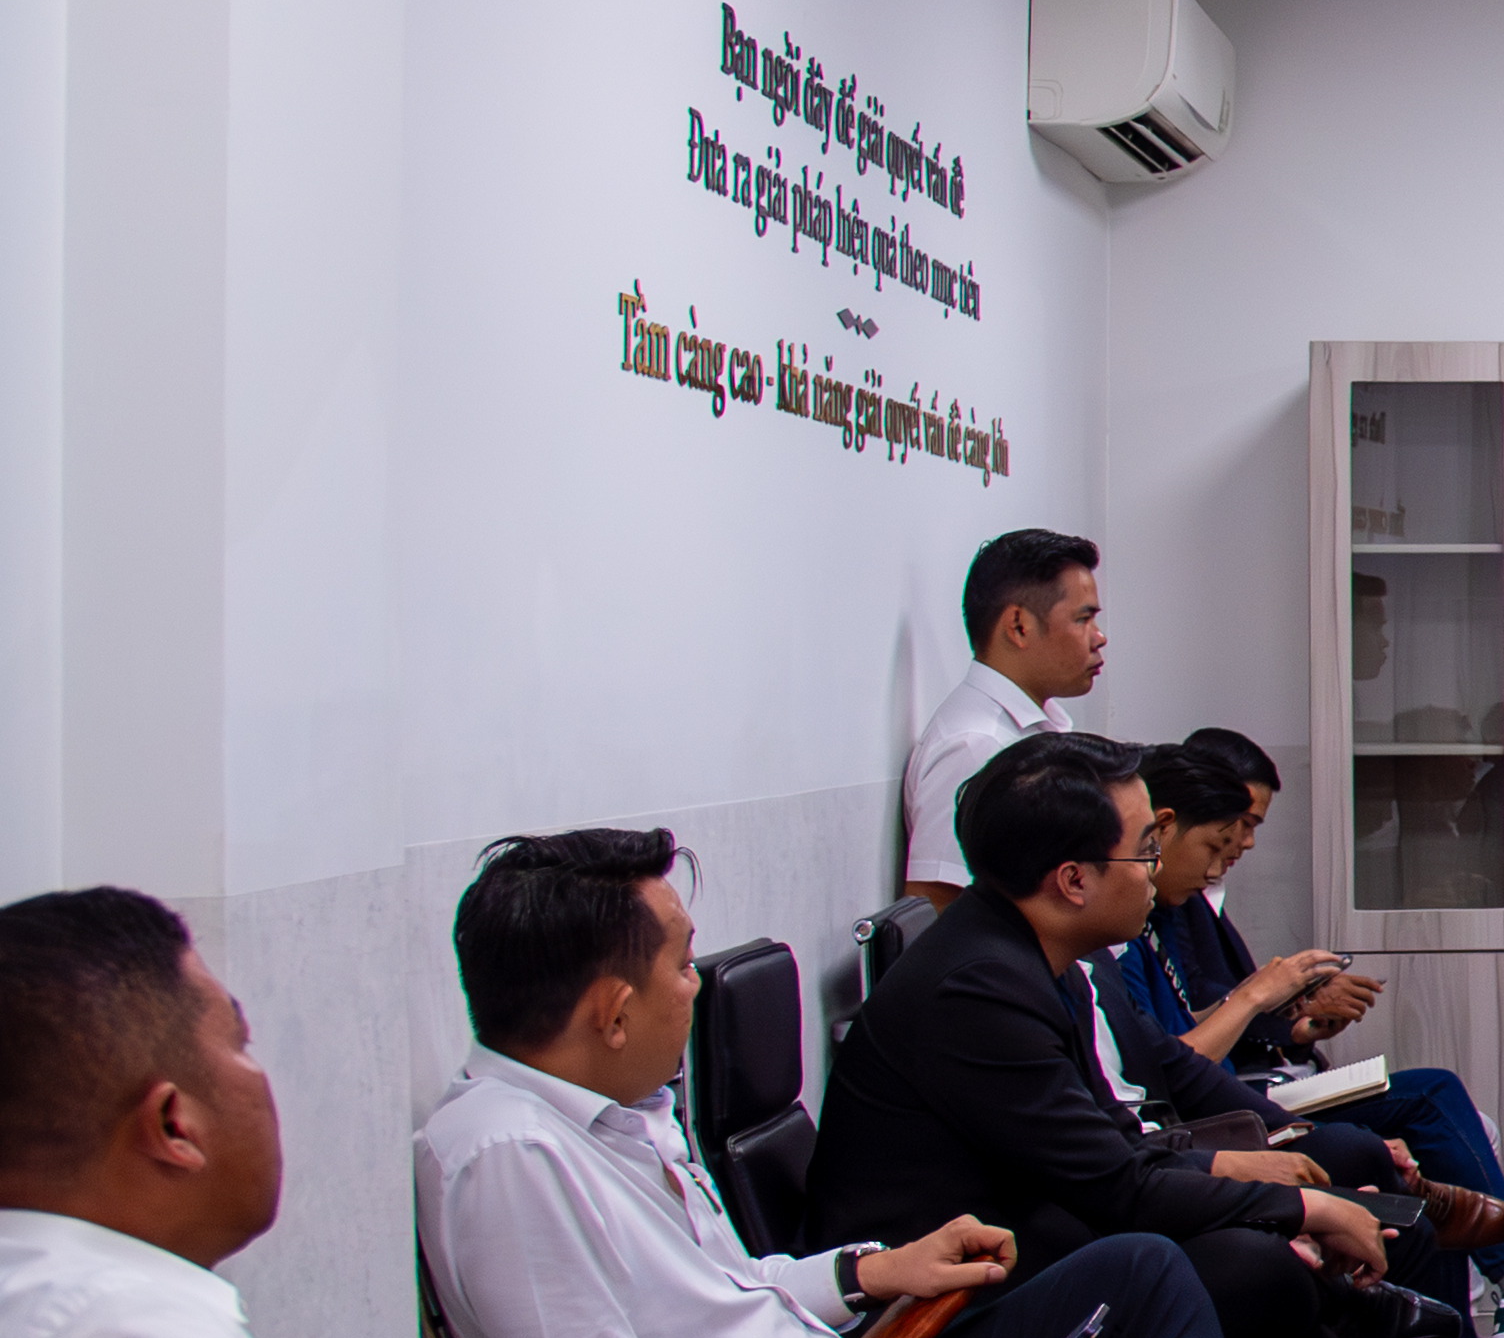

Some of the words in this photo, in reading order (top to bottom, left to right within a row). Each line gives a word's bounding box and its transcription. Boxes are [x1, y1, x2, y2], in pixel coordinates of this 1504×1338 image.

[687, 106, 727, 195] Đưa
[732, 148, 753, 207] ra
[755, 145, 789, 237] giải
[791, 164, 833, 266] pháp
[835, 184, 869, 276] hiệu
[872, 215, 898, 292] quả
[900, 223, 929, 295] theo
[931, 258, 958, 319] mục
[959, 260, 981, 321] tiêu
[721, 2, 759, 101] Bạn
[761, 31, 802, 127] ngồi
[804, 57, 834, 155] đây
[835, 74, 857, 150] để
[857, 96, 884, 175] giải
[886, 122, 924, 202] quyết
[924, 142, 948, 209] vấn
[949, 155, 965, 219] đề
[618, 278, 672, 381] Tầm
[675, 304, 727, 418] càng
[729, 347, 764, 406] cao
[776, 339, 810, 418] khả
[812, 355, 854, 450] năng
[855, 368, 883, 453] giải
[885, 382, 922, 465] quyết
[923, 390, 945, 458] vấn
[947, 398, 961, 463] đề
[963, 407, 991, 488] càng
[991, 417, 1010, 477] lớn
